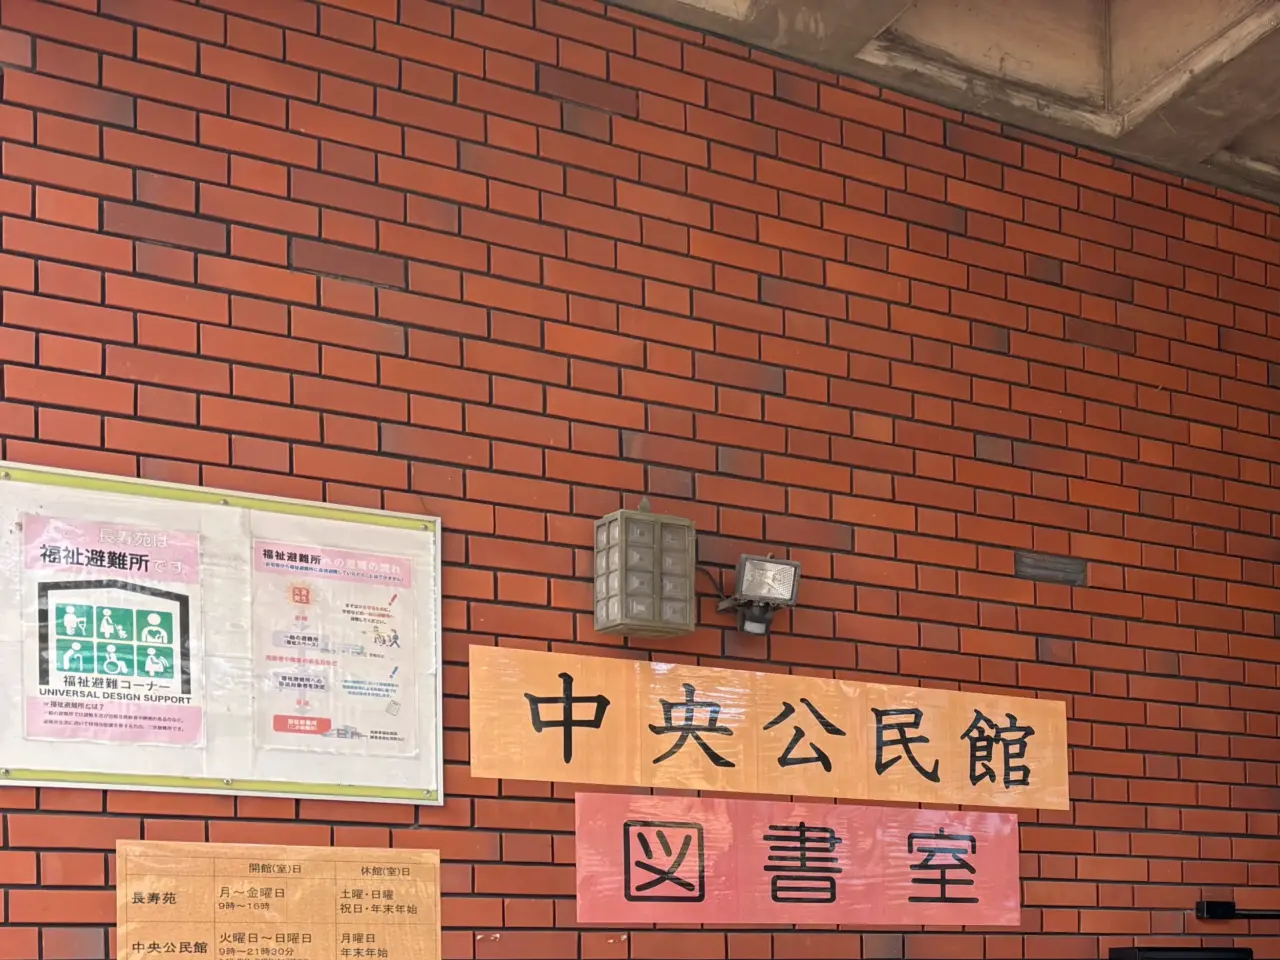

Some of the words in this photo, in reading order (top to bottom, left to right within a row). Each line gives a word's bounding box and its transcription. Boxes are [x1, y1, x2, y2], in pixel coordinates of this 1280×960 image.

[63, 675, 171, 692] 福祉避難コーナー
[39, 688, 99, 699] UNIVERSAL
[102, 692, 141, 702] DESIGN
[144, 694, 192, 705] SUPPORT
[523, 671, 1036, 790] 中央公民館
[622, 820, 980, 904] 図書室
[131, 891, 177, 905] 長寿苑
[339, 889, 394, 901] 土曜・日曜
[339, 903, 418, 915] 祝日・年末年始
[219, 932, 312, 944] 火曜日～日曜日
[339, 933, 376, 944] 月曜日
[132, 941, 208, 955] 中央公民館
[339, 947, 389, 958] 年末年始
